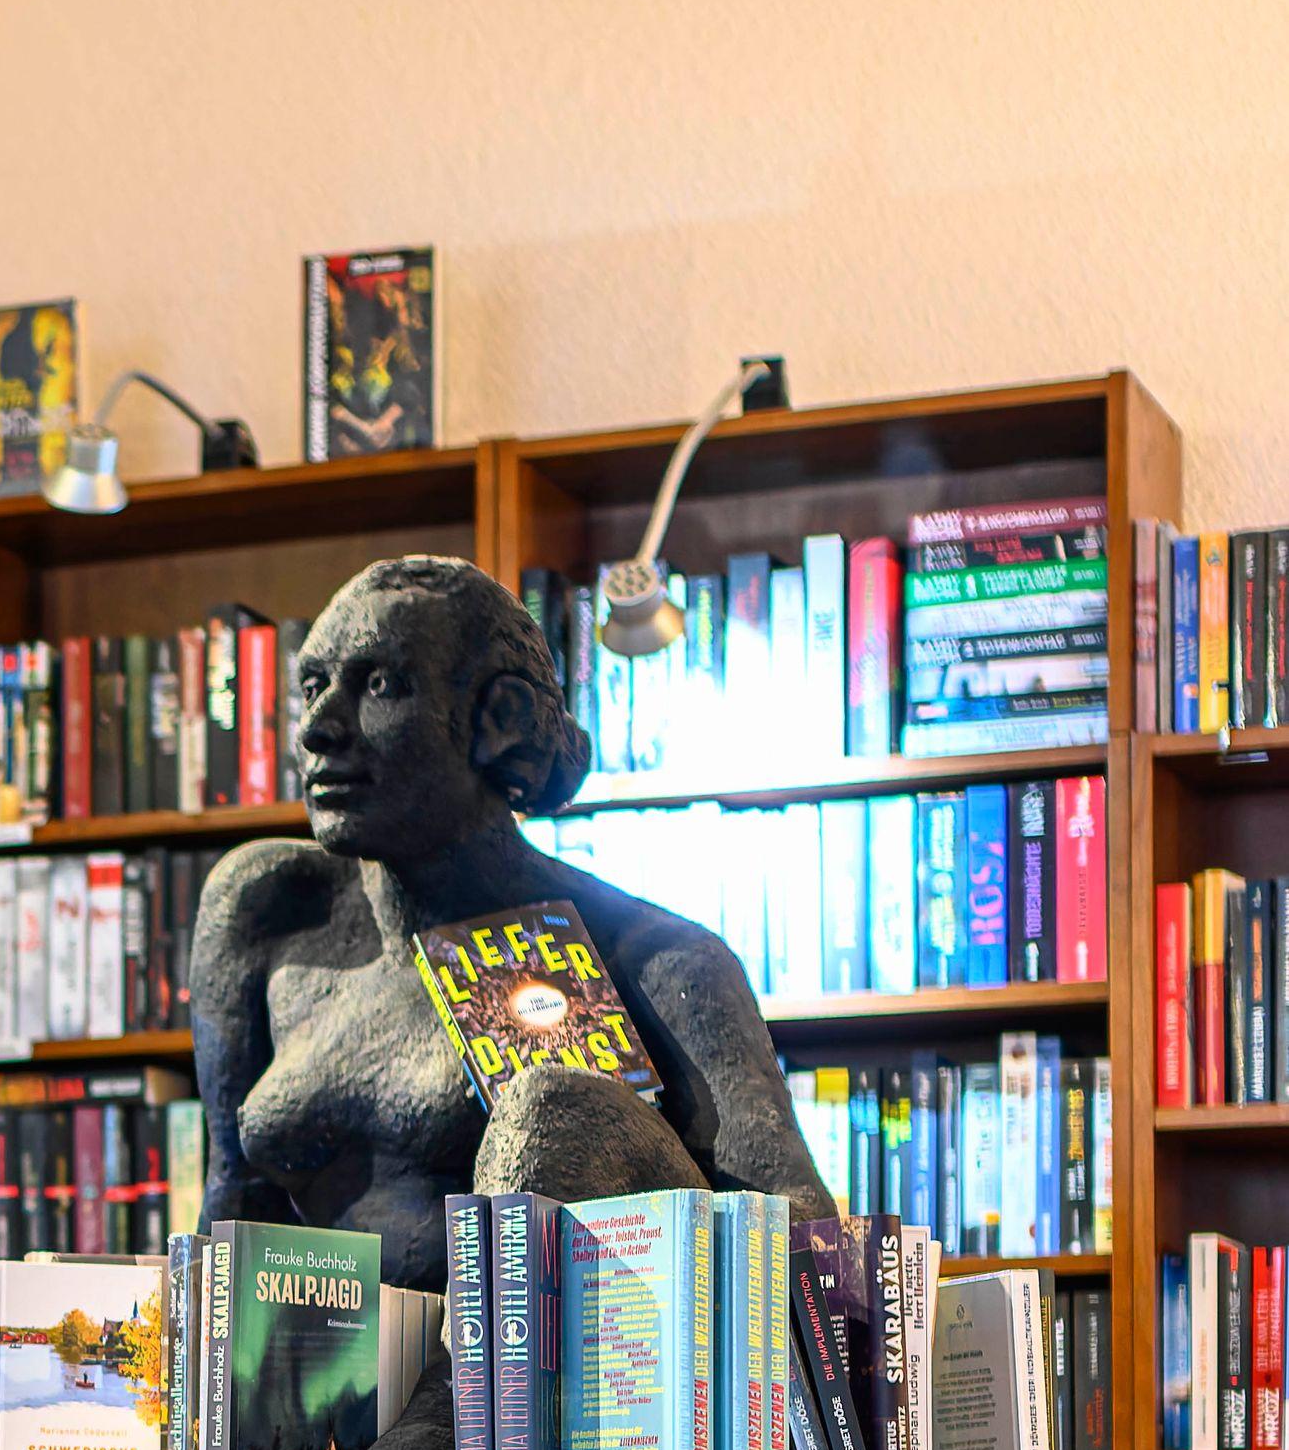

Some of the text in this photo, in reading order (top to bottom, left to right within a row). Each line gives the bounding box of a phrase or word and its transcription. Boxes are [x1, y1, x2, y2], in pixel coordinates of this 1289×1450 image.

[439, 924, 601, 1004] LIEFER
[264, 1248, 357, 1271] Frauke Buchholz
[694, 1226, 709, 1347] WELTLITERATUR
[256, 1271, 362, 1310] SKALPJAGD
[876, 1235, 904, 1384] SKARABÄUS
[695, 1349, 709, 1376] DER
